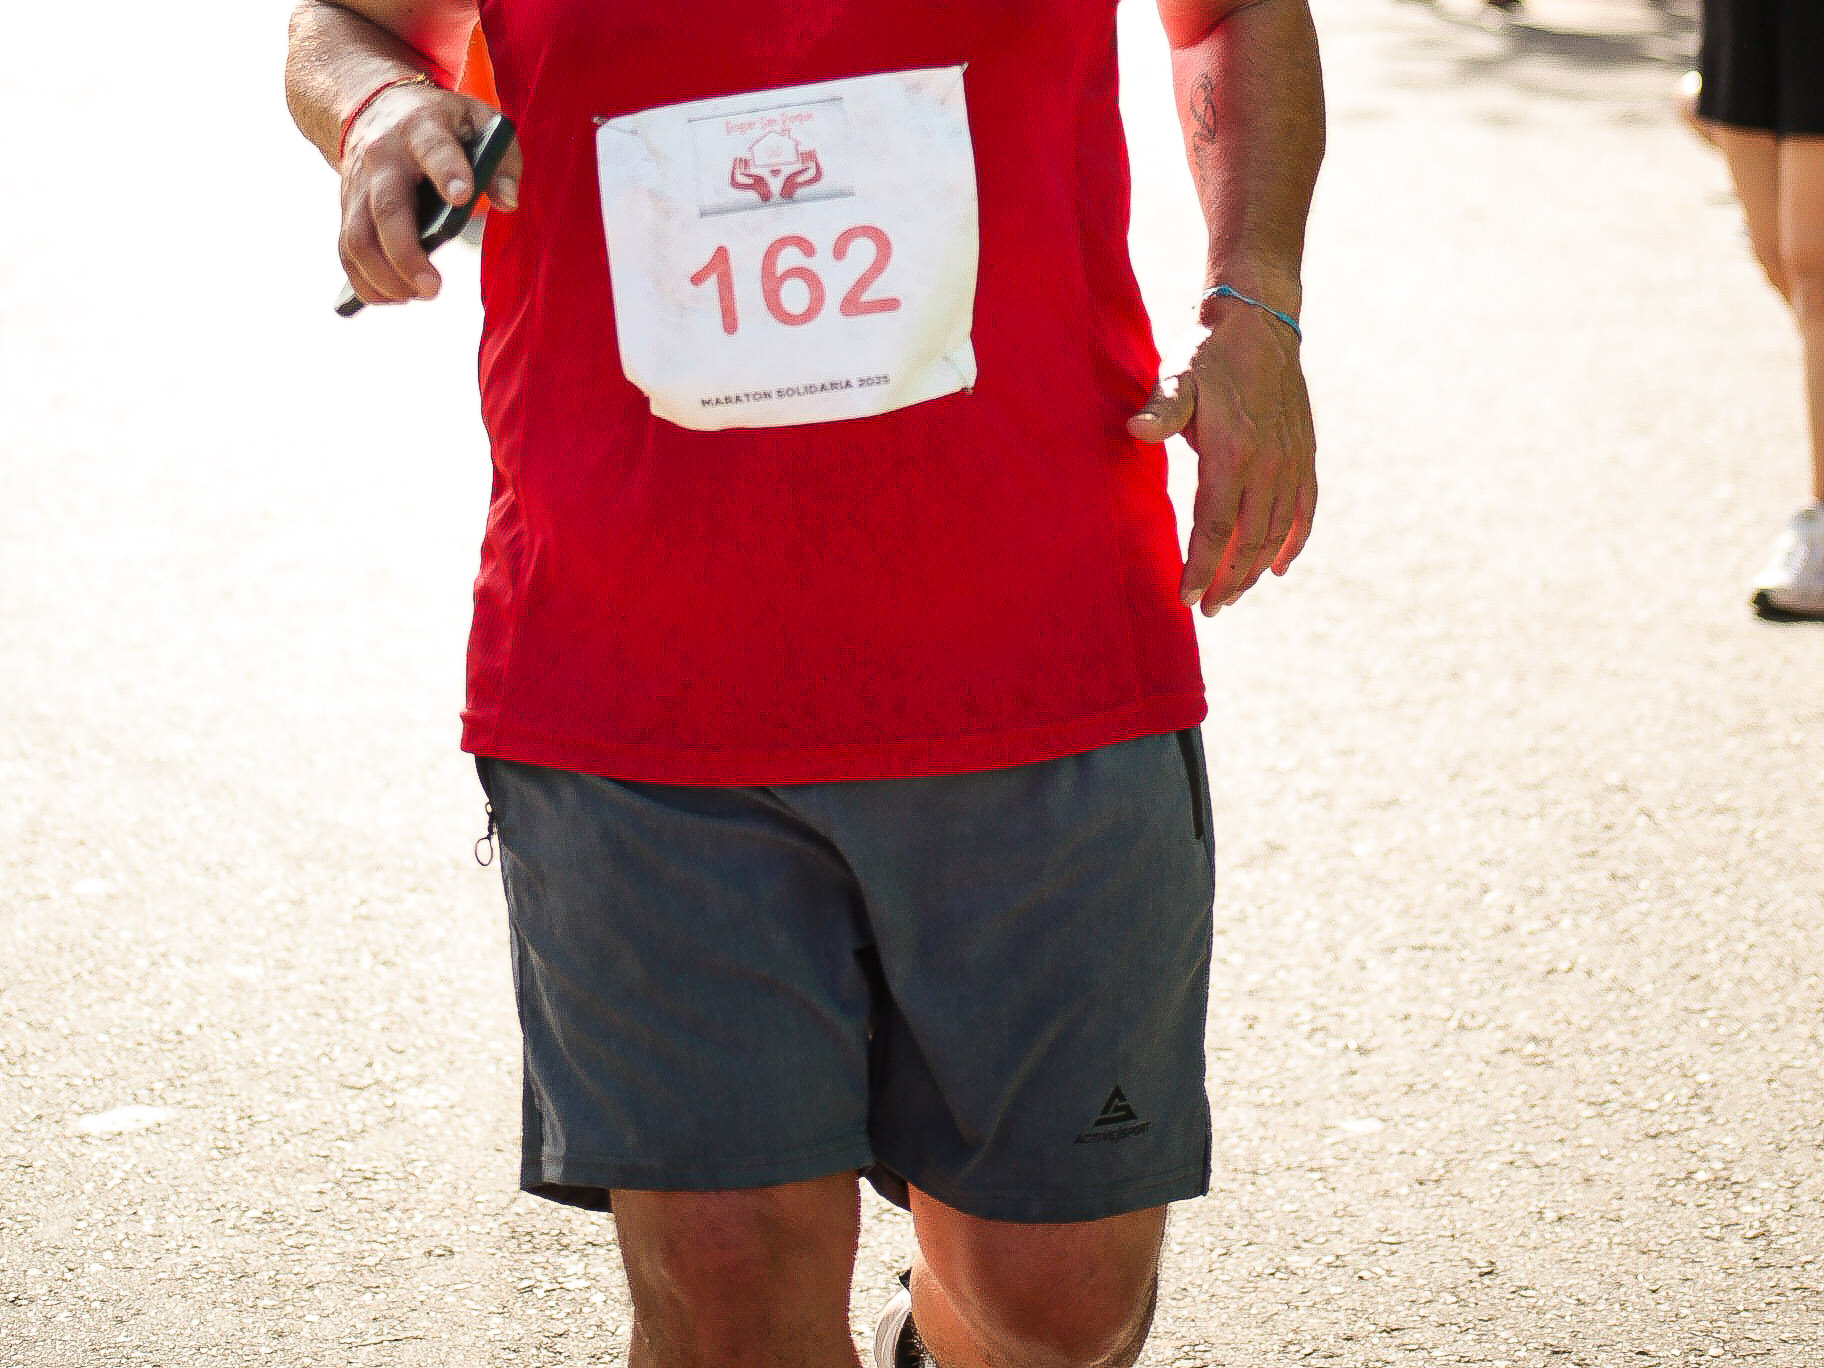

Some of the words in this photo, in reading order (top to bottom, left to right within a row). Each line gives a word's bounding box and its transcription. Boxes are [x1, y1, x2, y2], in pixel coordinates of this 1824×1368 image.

[690, 225, 901, 335] 162
[701, 390, 773, 407] MARATON
[776, 379, 853, 399] SOLIDARIA
